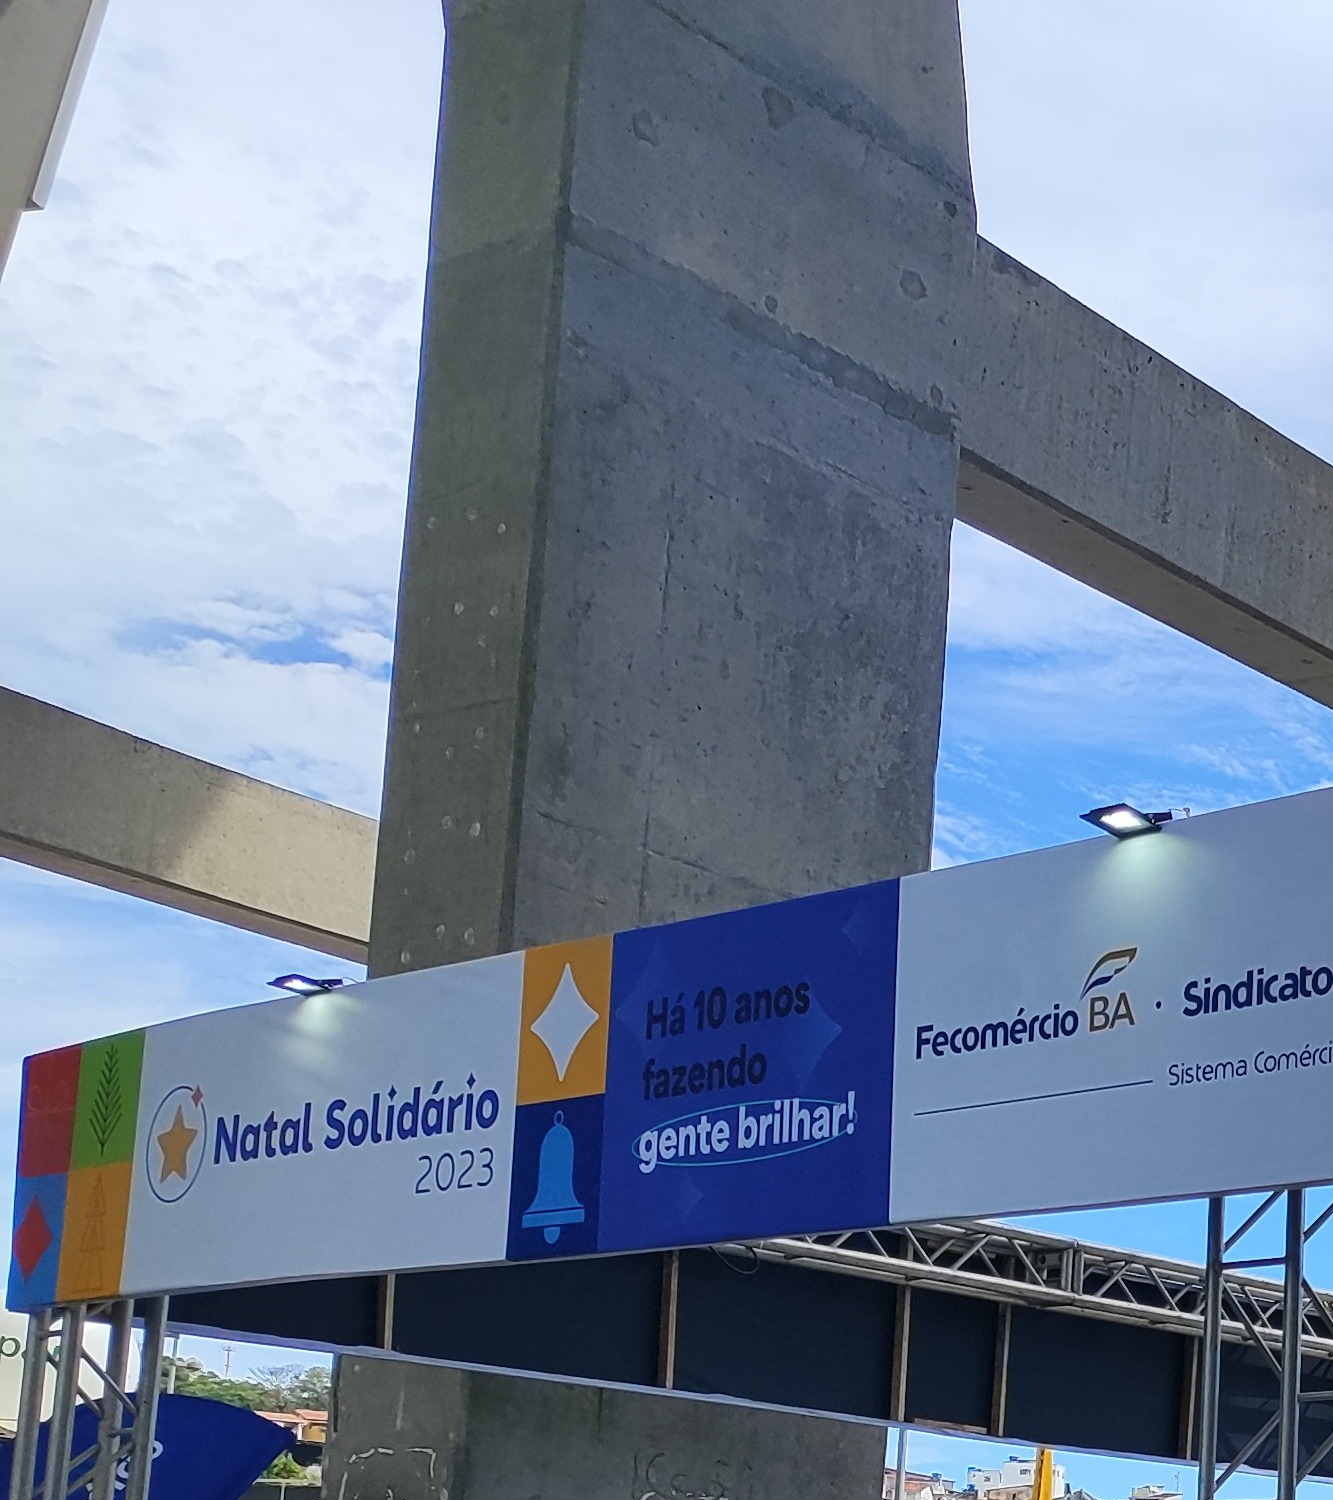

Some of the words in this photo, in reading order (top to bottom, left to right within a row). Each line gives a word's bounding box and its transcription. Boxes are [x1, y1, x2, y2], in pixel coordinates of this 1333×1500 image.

[645, 995, 686, 1041] Há
[694, 990, 728, 1032] 10
[733, 977, 811, 1024] anos
[915, 1002, 1079, 1059] Fecomércio
[1087, 990, 1135, 1034] BA
[642, 1047, 768, 1101] fazendo
[1168, 1052, 1248, 1087] Sistema
[213, 1101, 313, 1164] Natal
[323, 1073, 500, 1152] Solidário
[638, 1120, 730, 1173] gente
[736, 1090, 856, 1150] brilhar!
[415, 1147, 496, 1195] 2023
